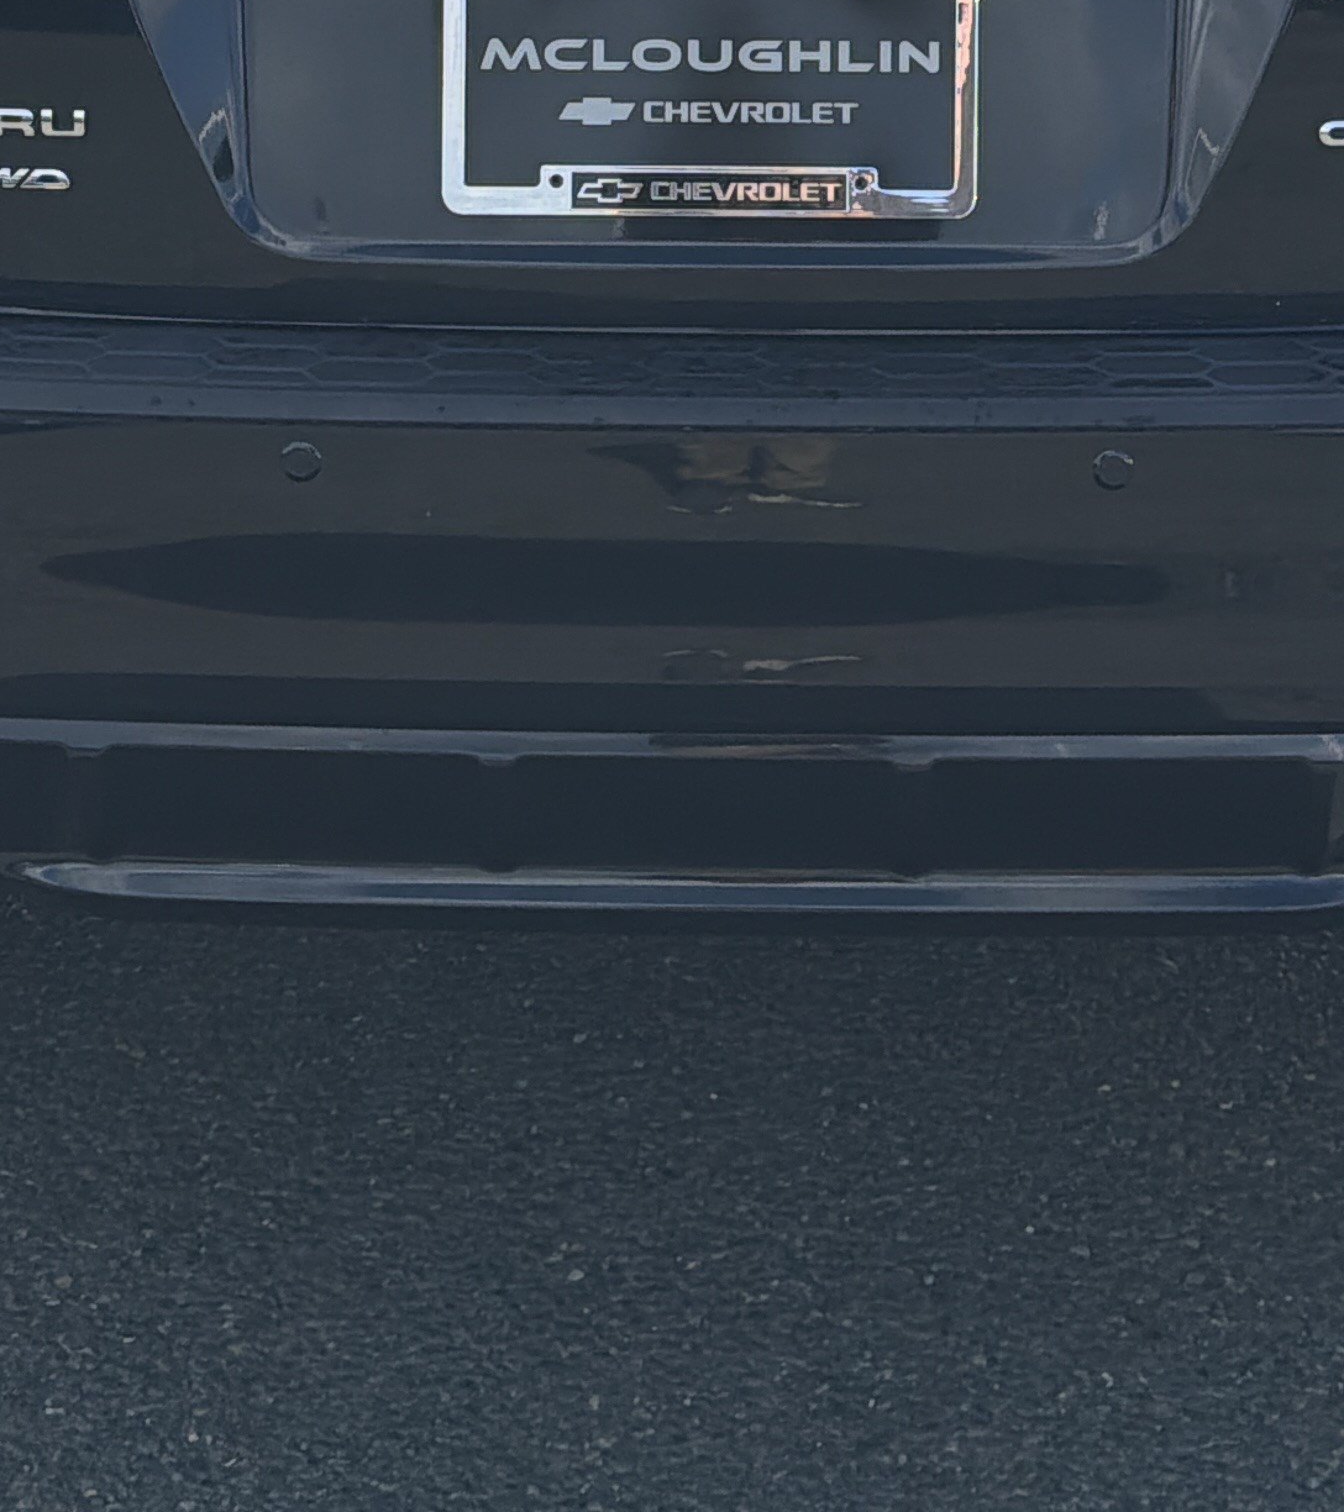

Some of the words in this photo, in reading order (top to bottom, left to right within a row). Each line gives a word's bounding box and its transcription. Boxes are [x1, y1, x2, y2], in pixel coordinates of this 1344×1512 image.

[480, 37, 941, 73] MCLOUGHLIN
[642, 100, 859, 125] CHEVROLET
[650, 180, 842, 203] CHEVROLET
